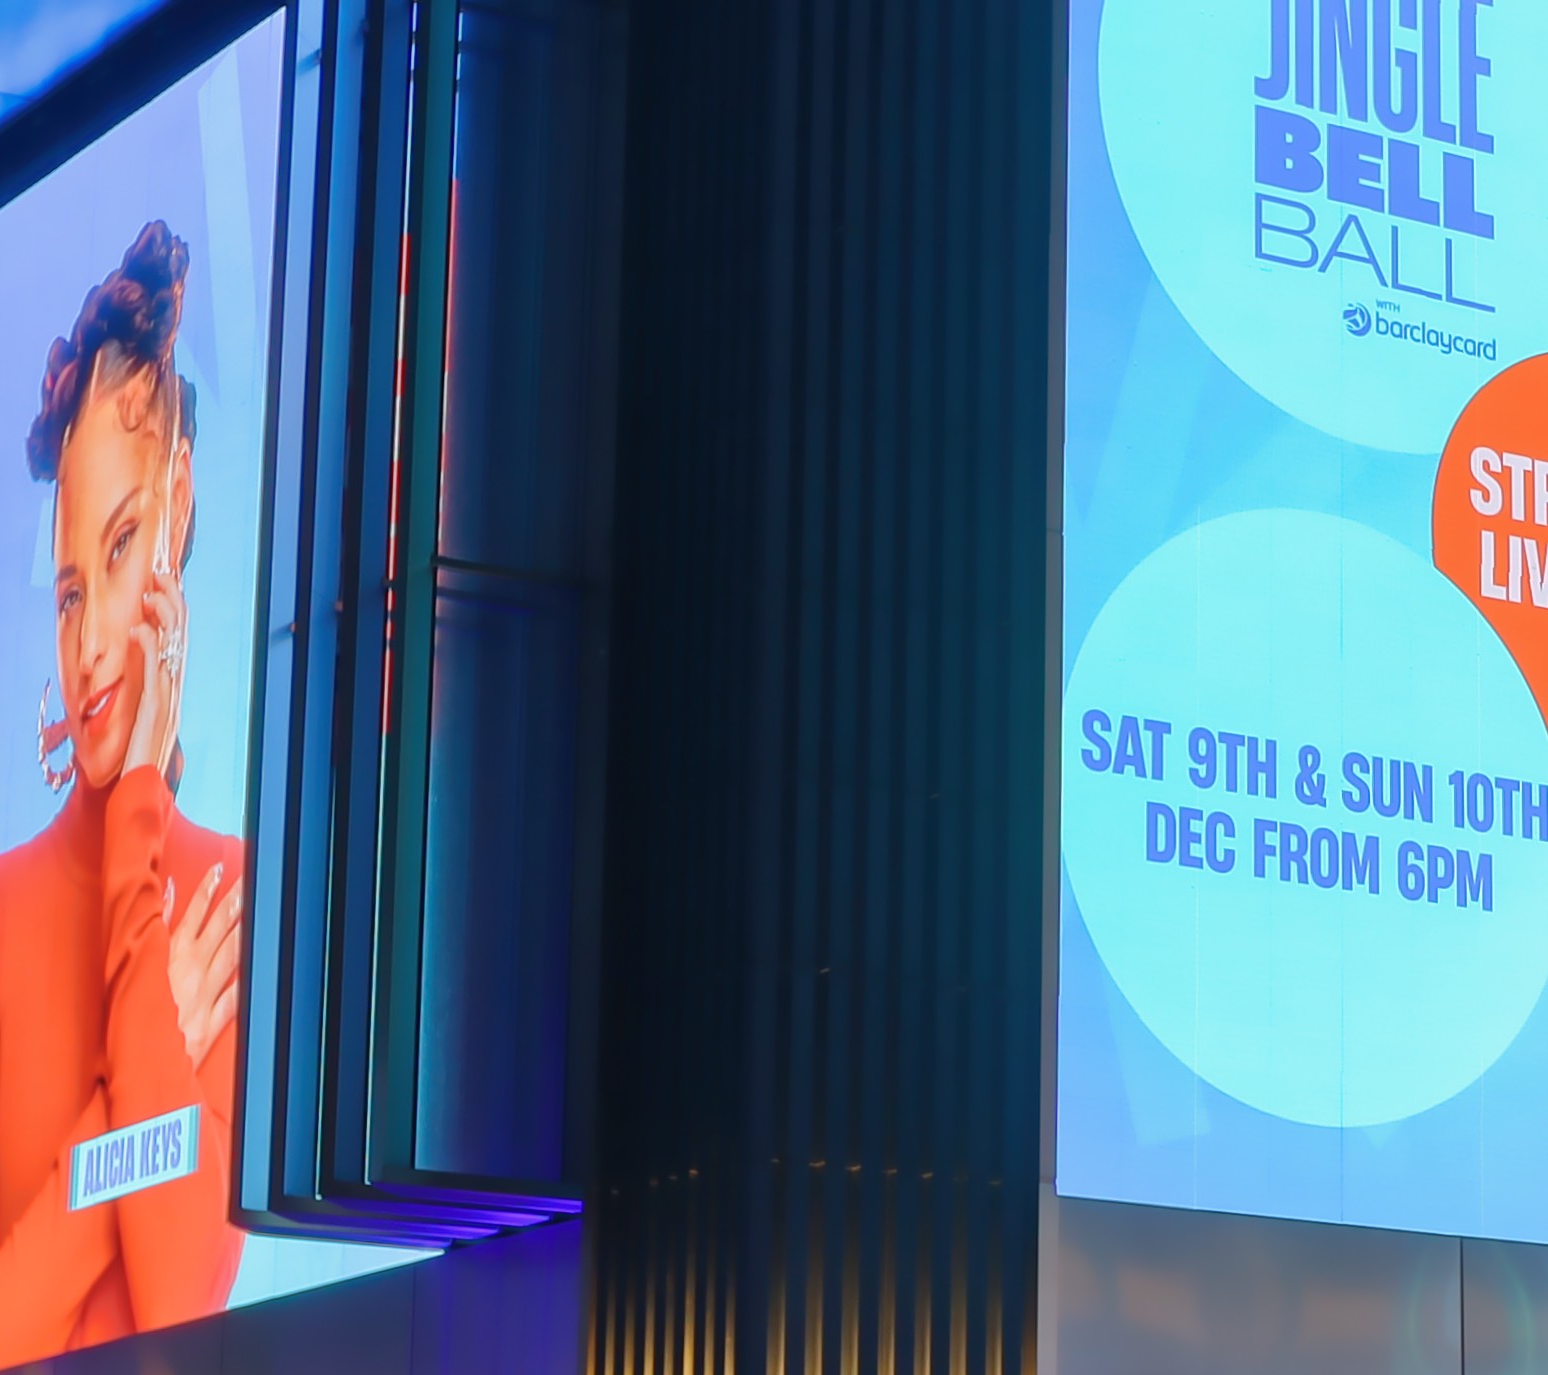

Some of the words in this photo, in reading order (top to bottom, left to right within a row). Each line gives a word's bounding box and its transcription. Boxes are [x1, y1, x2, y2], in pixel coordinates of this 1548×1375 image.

[1254, 104, 1494, 239] BELL
[1254, 191, 1496, 313] BALL
[1375, 299, 1401, 313] WITH
[1375, 311, 1497, 361] barclaycard
[1080, 709, 1172, 781] SAT
[1188, 727, 1278, 800] 9TH
[1294, 744, 1327, 808] &
[1341, 752, 1434, 824] SUN
[1145, 802, 1236, 874] DEC
[1253, 819, 1381, 895] FROM
[1396, 840, 1494, 913] 6PM
[83, 1133, 135, 1197] ALICIA
[139, 1118, 182, 1179] KEYS
